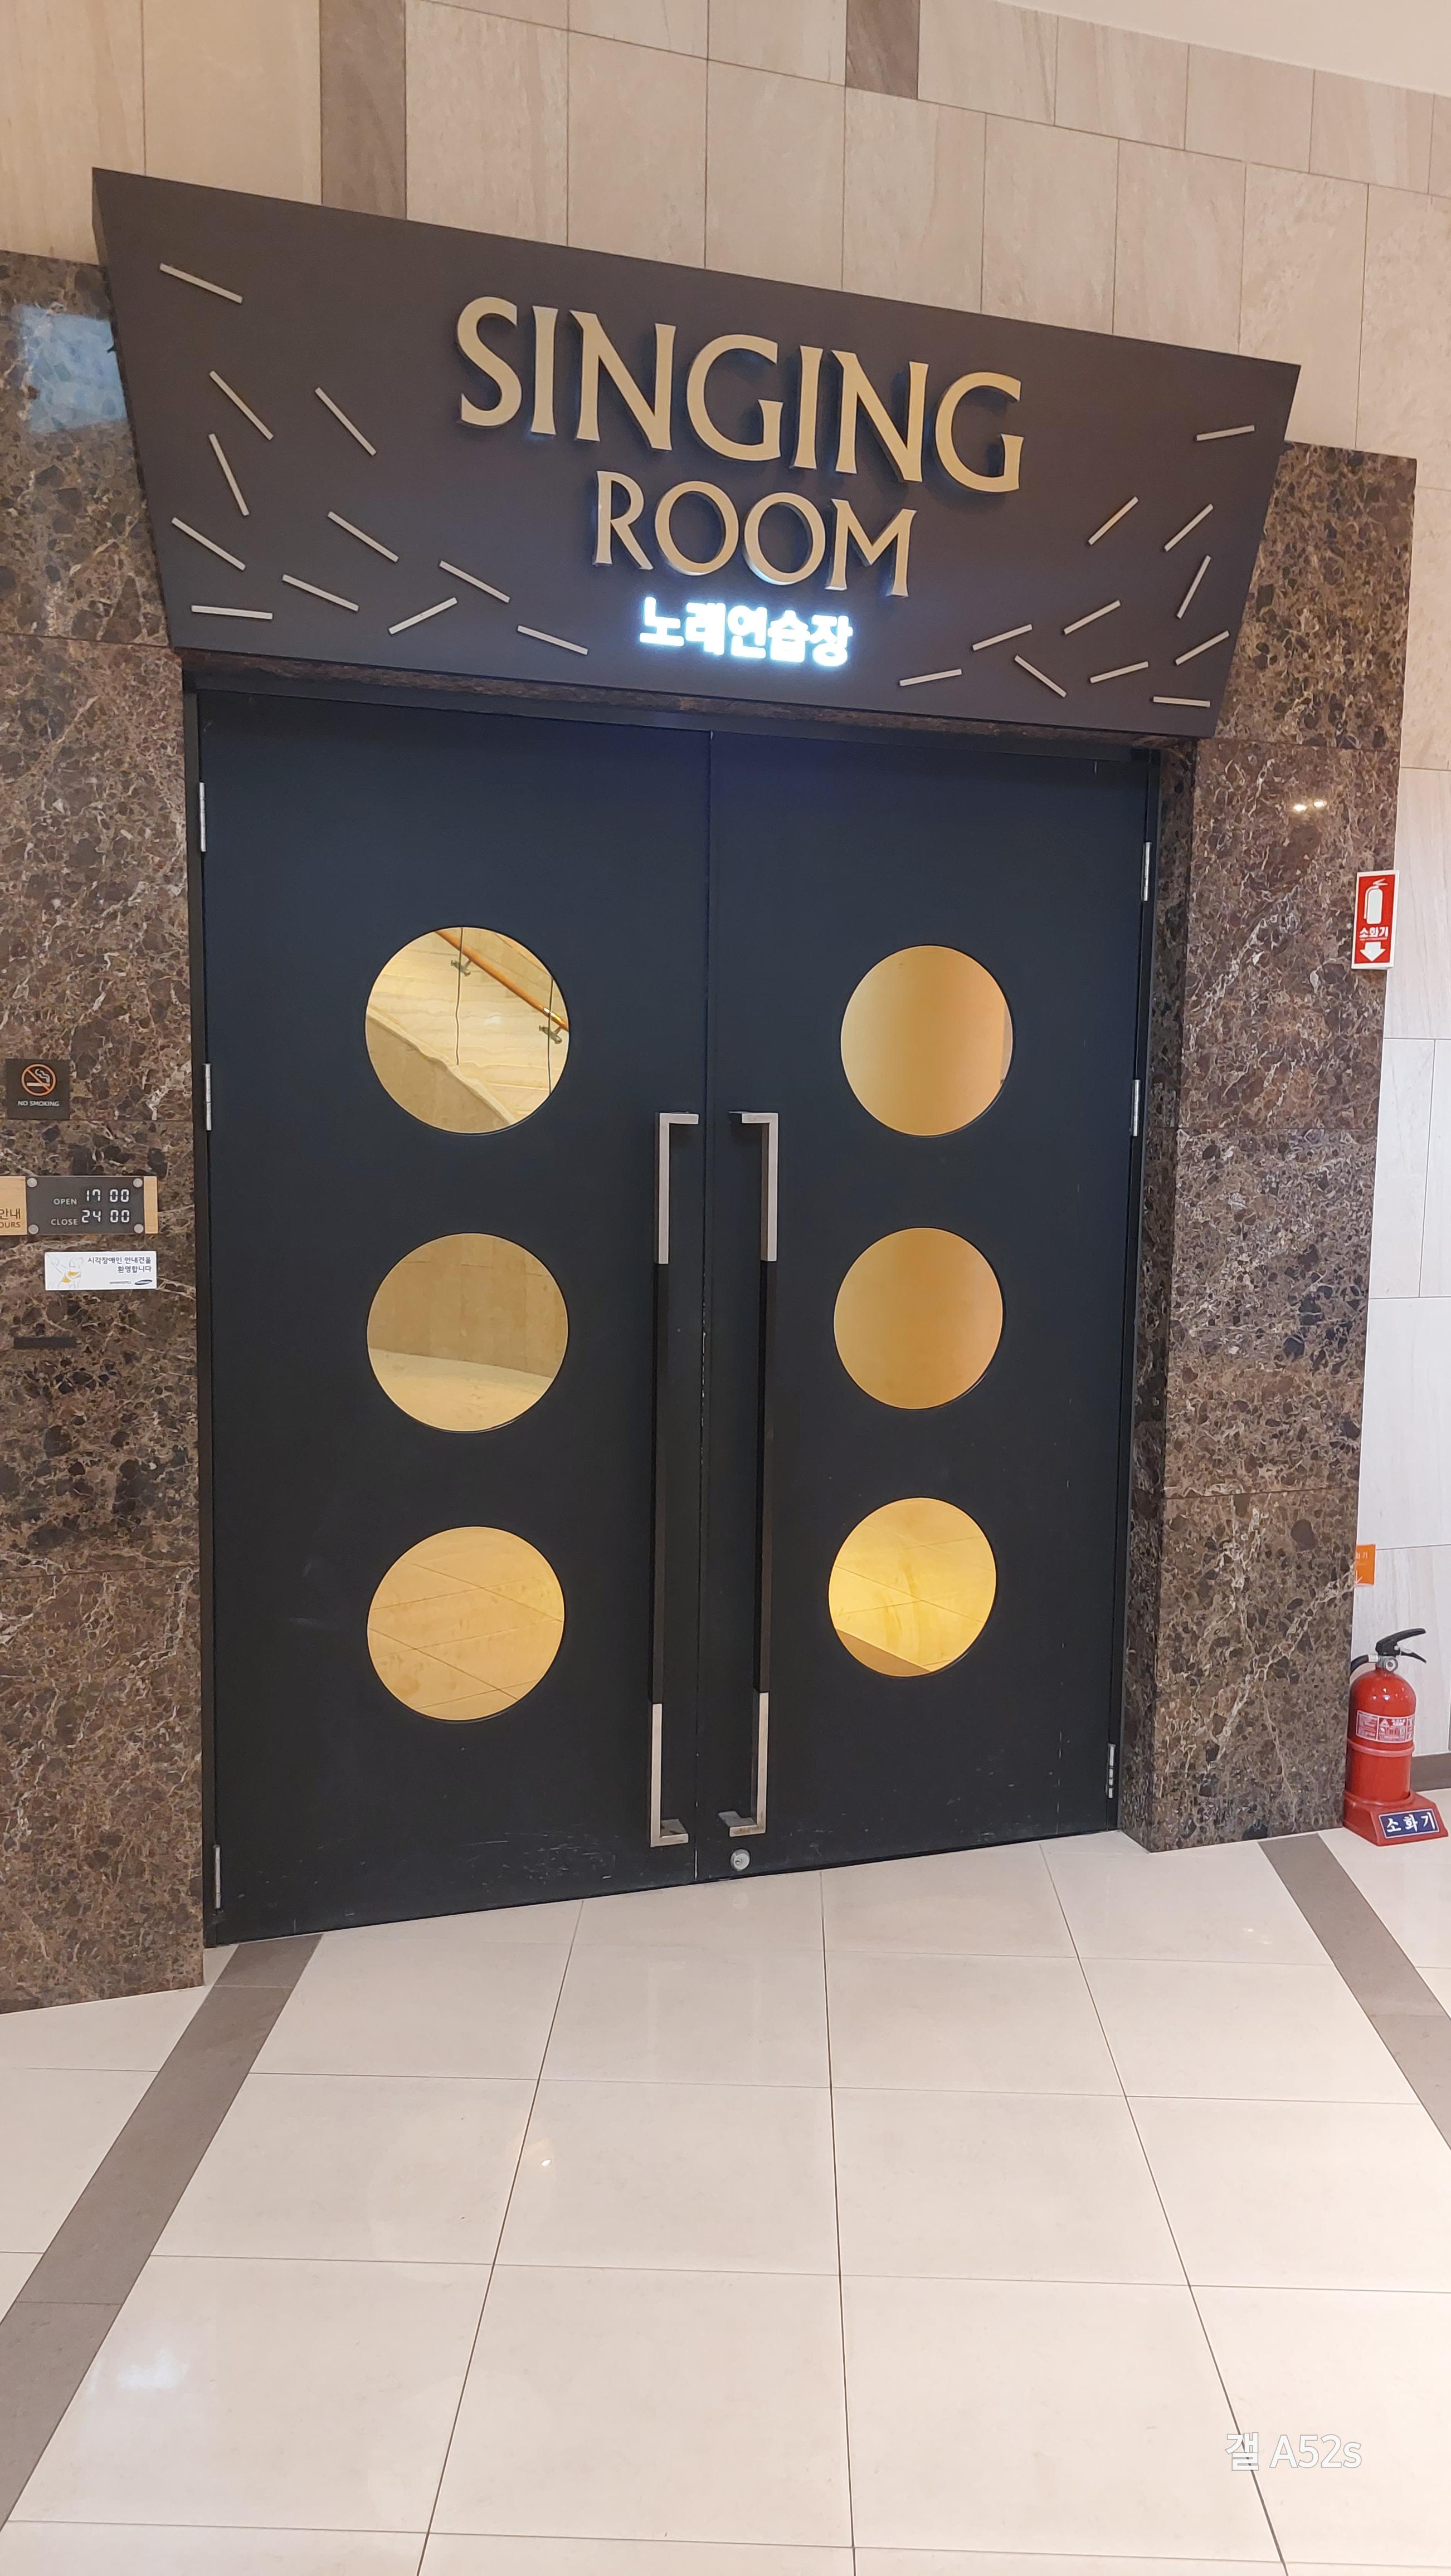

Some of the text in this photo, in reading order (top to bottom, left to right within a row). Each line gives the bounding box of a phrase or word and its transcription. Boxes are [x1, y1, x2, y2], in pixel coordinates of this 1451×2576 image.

[456, 296, 1024, 493] SINGING
[592, 470, 917, 597] ROOM
[639, 597, 853, 667] 노래연습장
[1359, 926, 1389, 938] 소화기
[86, 1189, 101, 1202] 17
[109, 1189, 129, 1202] 00
[81, 1209, 101, 1223] 24
[110, 1209, 130, 1223] 00
[118, 1265, 152, 1274] 환영합니다
[1386, 1812, 1435, 1833] 소화기
